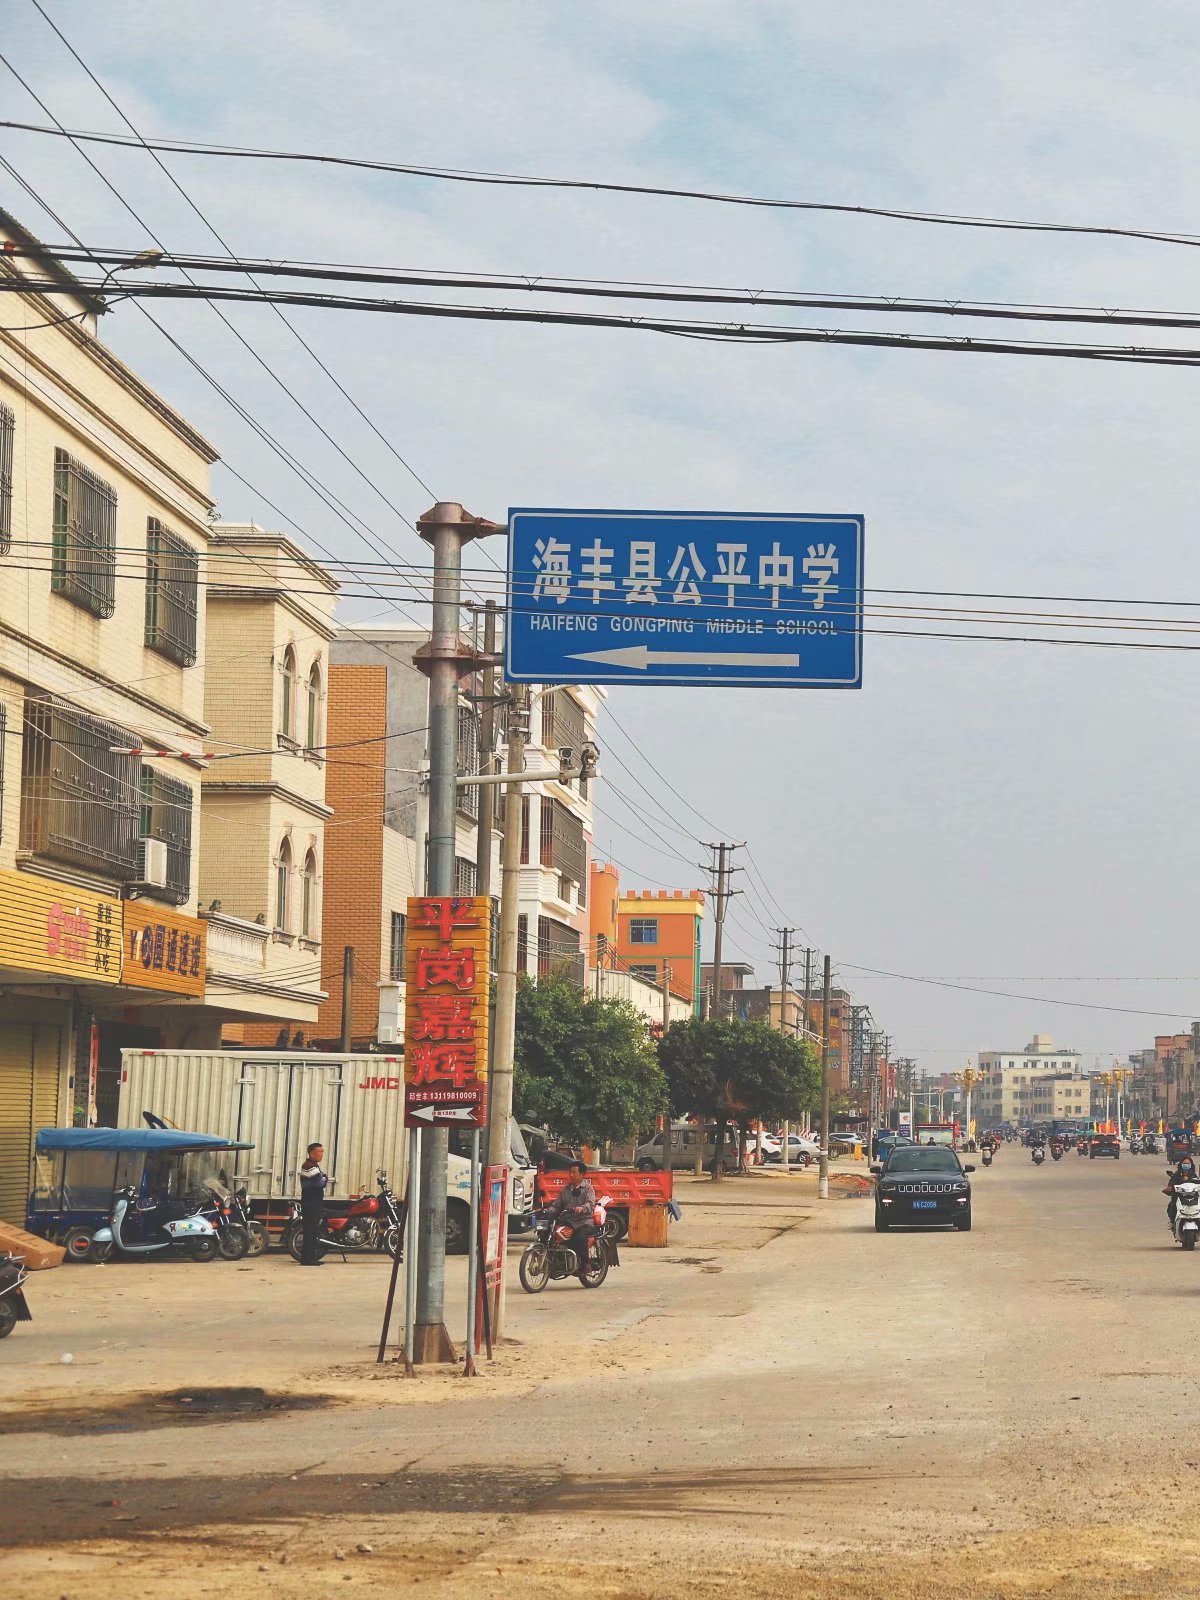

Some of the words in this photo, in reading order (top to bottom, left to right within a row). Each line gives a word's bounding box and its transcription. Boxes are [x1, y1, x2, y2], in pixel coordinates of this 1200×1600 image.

[531, 536, 839, 610] 海丰县公平中学
[530, 614, 598, 632] HAIFENG
[610, 616, 694, 634] GONGPING
[706, 618, 763, 635] MIDDLE
[776, 619, 838, 636] SCHOOL
[359, 1077, 399, 1090] JMC
[430, 1091, 477, 1100] 13119810009
